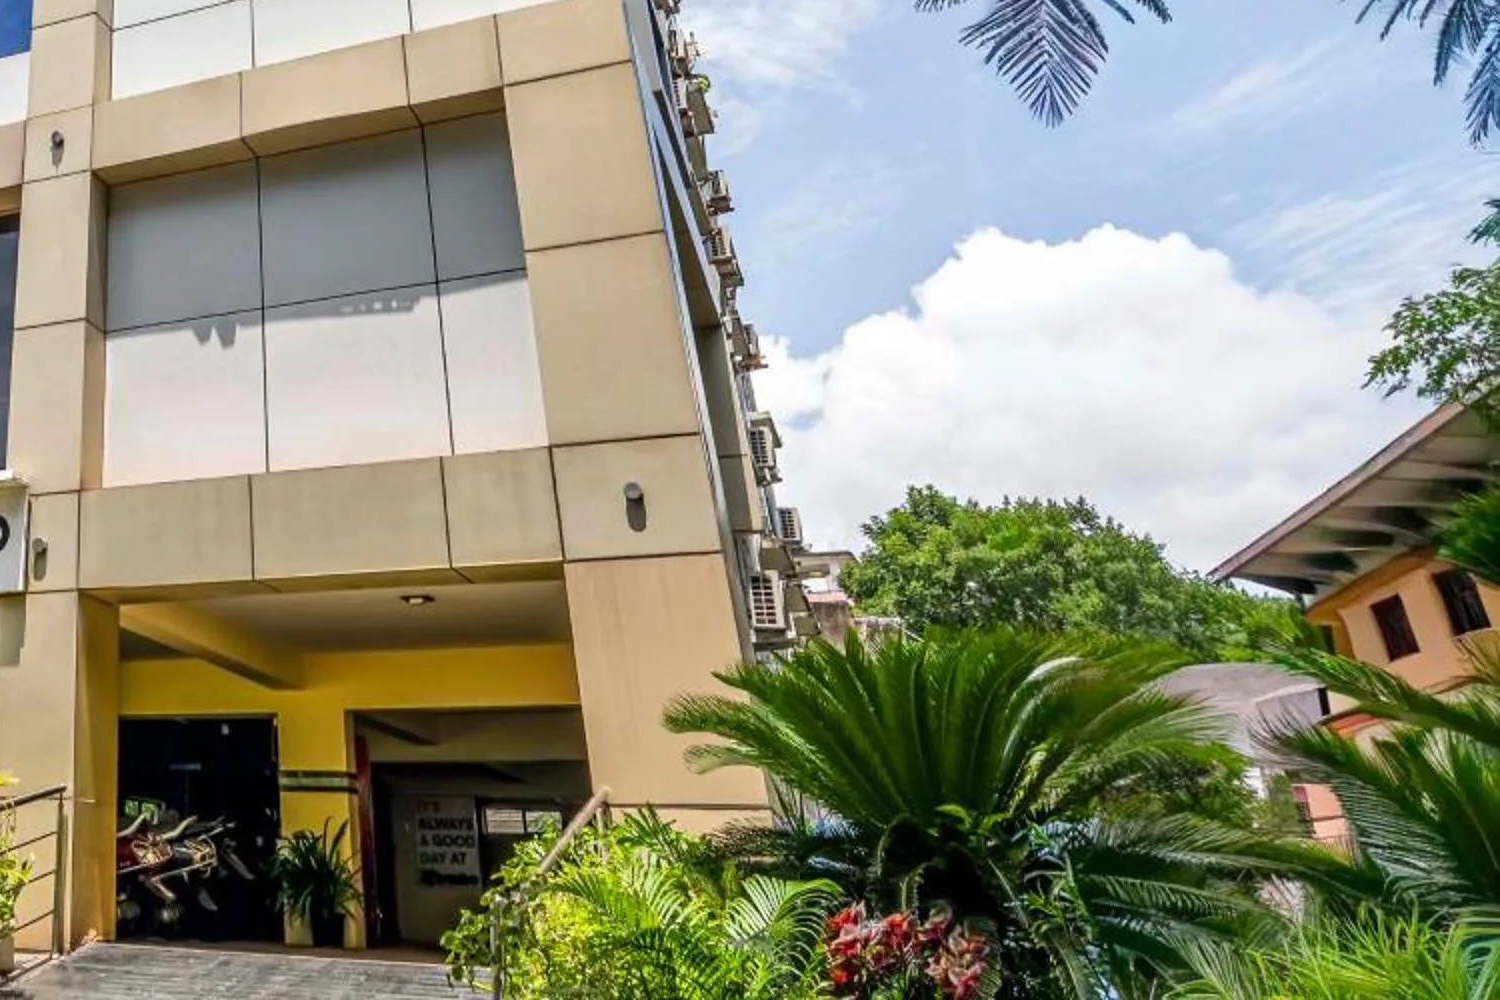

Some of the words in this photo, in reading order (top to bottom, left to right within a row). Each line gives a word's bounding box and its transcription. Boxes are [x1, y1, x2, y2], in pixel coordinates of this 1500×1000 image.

[418, 817, 474, 831] ALWAYS
[420, 834, 428, 847] A
[432, 834, 475, 848] GOOD
[420, 851, 446, 865] DAY
[450, 852, 467, 866] AT
